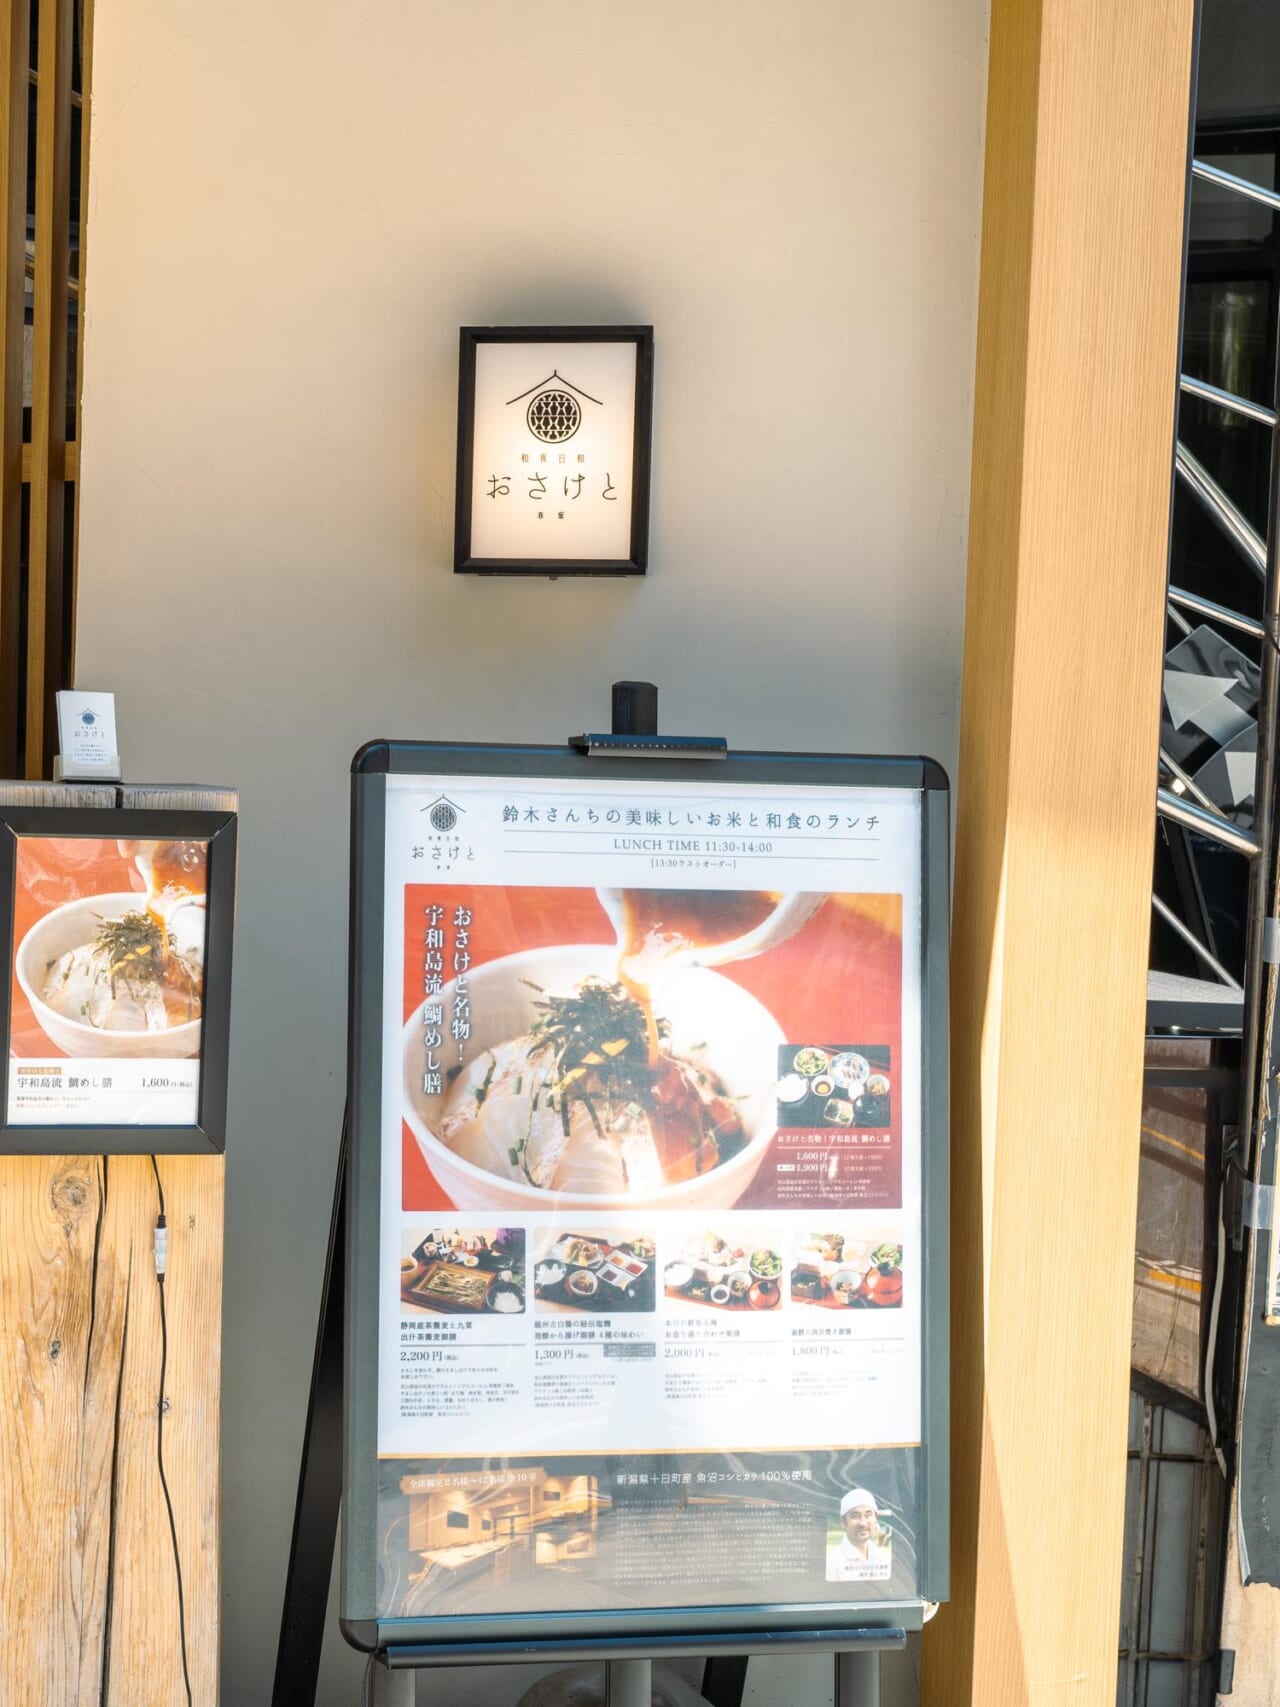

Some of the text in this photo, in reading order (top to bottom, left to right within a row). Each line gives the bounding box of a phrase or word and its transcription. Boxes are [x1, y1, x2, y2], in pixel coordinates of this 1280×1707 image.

[486, 472, 618, 501] おさけと
[502, 804, 881, 831] 鈴木さんちの美味しいお米と和食のランチ
[411, 845, 476, 861] おさけと
[614, 838, 773, 853] LUNCH TIME 11:30-14:00
[423, 905, 444, 1094] 宇和島流 鯛めし膳
[16, 1076, 63, 1089] 宇和島流
[616, 1472, 692, 1485] 新潟県十日町産
